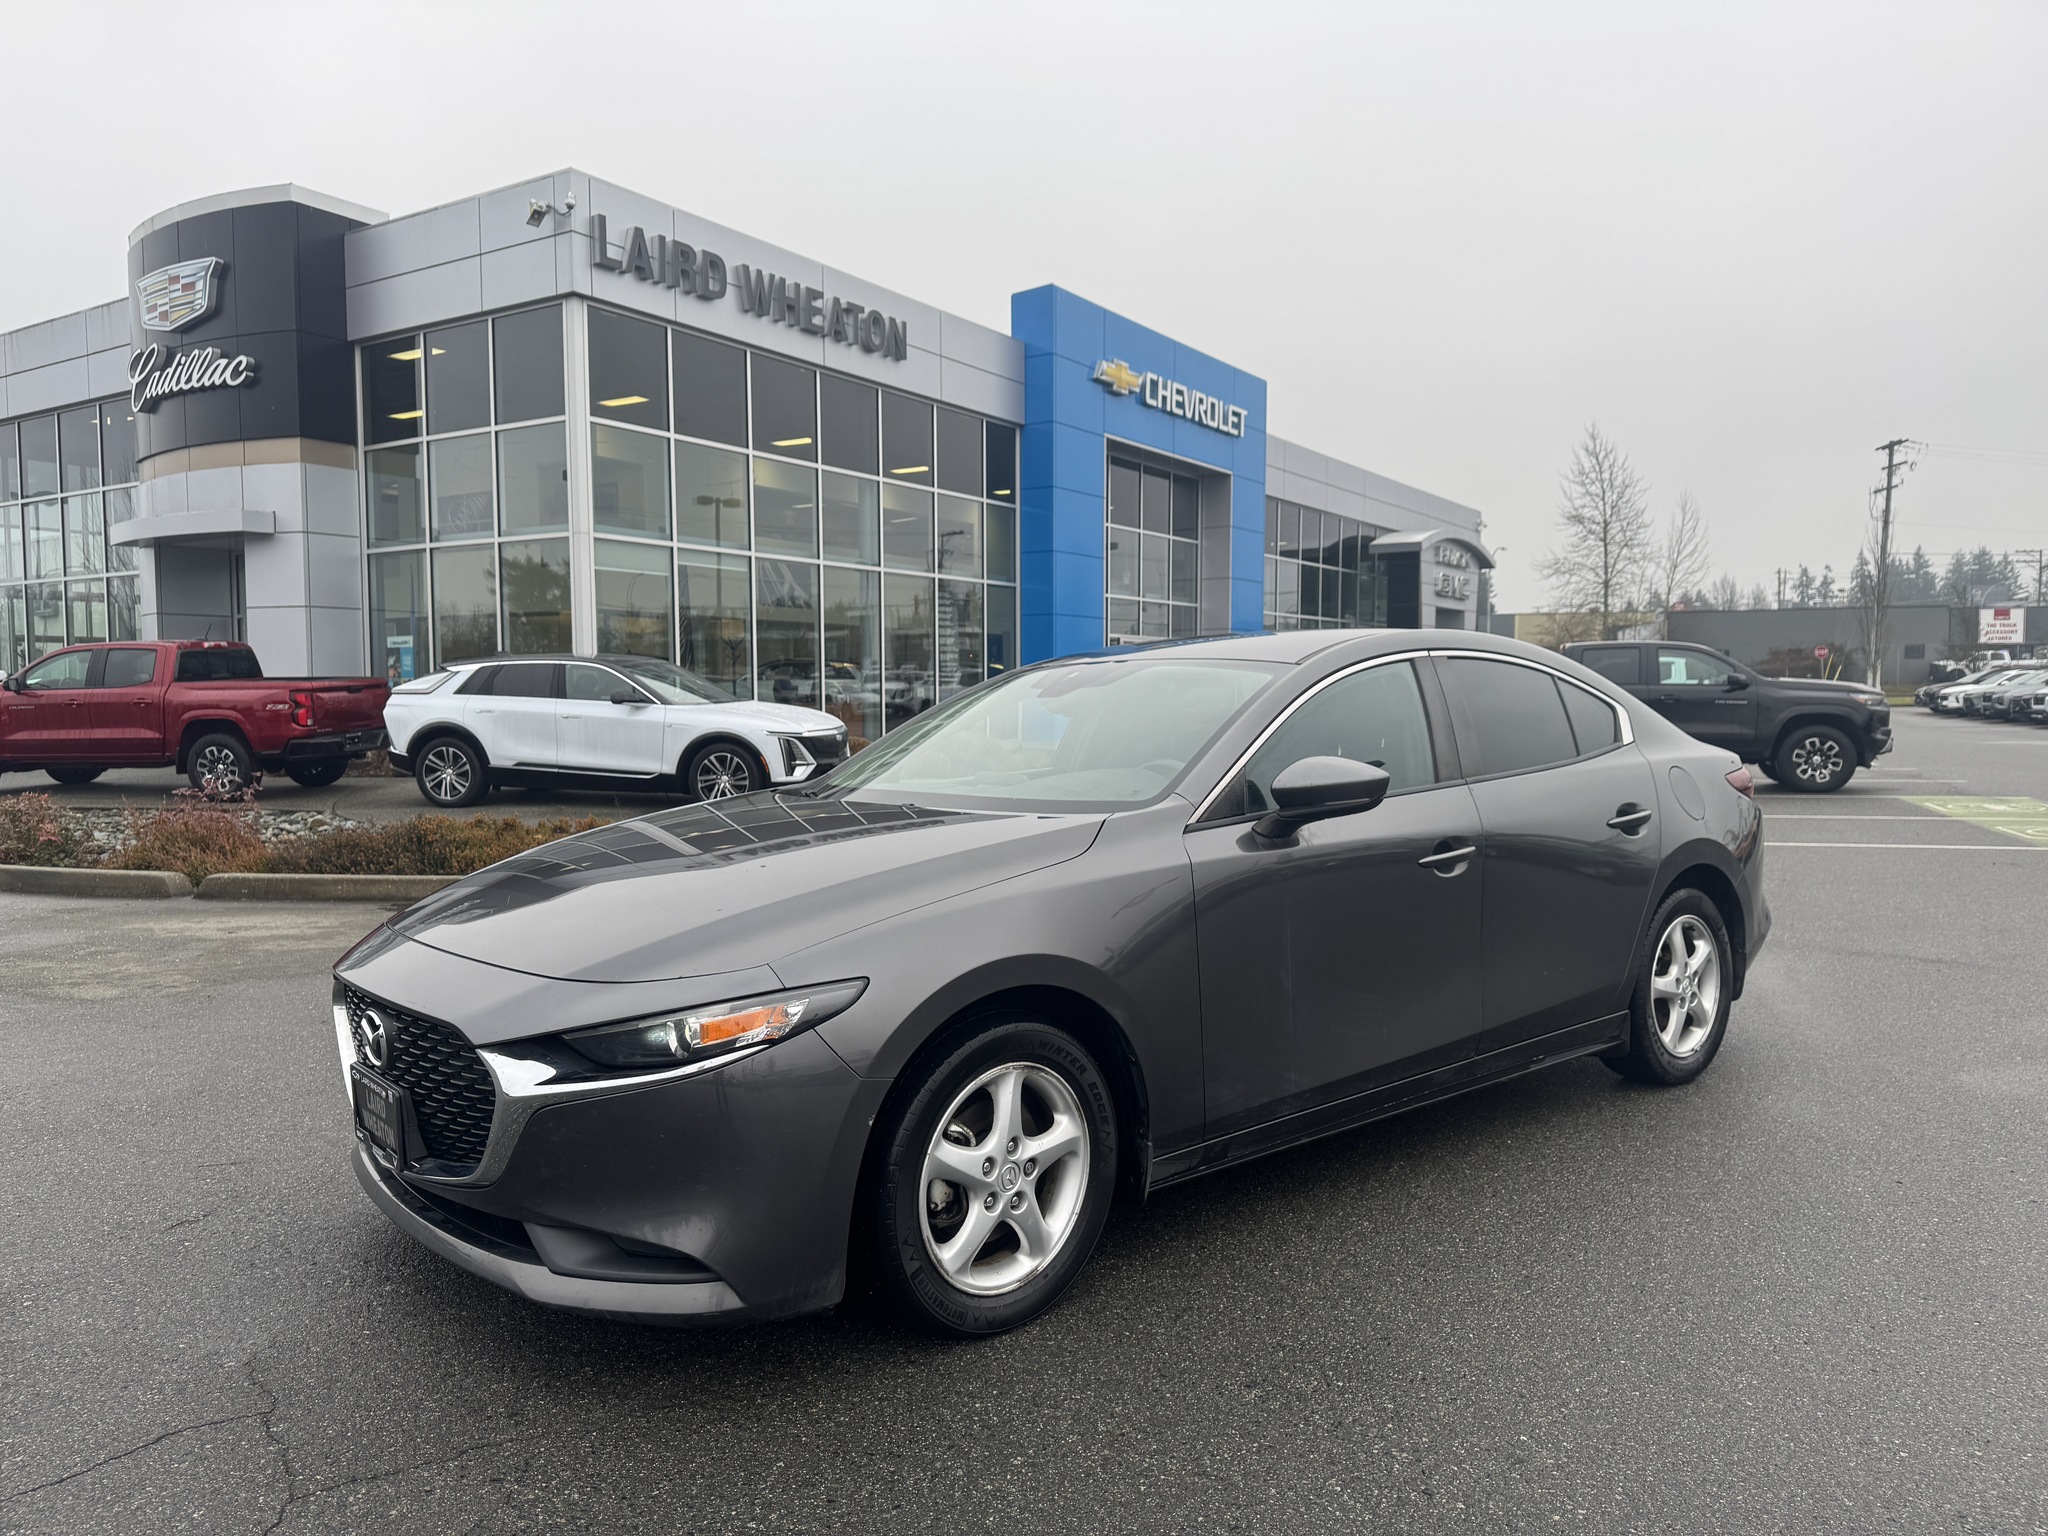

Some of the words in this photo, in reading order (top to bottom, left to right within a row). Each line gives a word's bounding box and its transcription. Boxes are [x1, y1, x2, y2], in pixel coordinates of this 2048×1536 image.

[591, 213, 728, 302] LAIRD
[735, 262, 908, 362] WHEATON
[127, 342, 253, 413] Cadillac
[1143, 370, 1249, 438] CHEVROLET
[365, 1088, 387, 1119] LAIRD
[1037, 1040, 1088, 1076] WINTER
[1087, 1081, 1110, 1126] EDGE
[361, 1107, 396, 1150] WHEATON
[916, 1272, 967, 1324] MOTOMASTER
